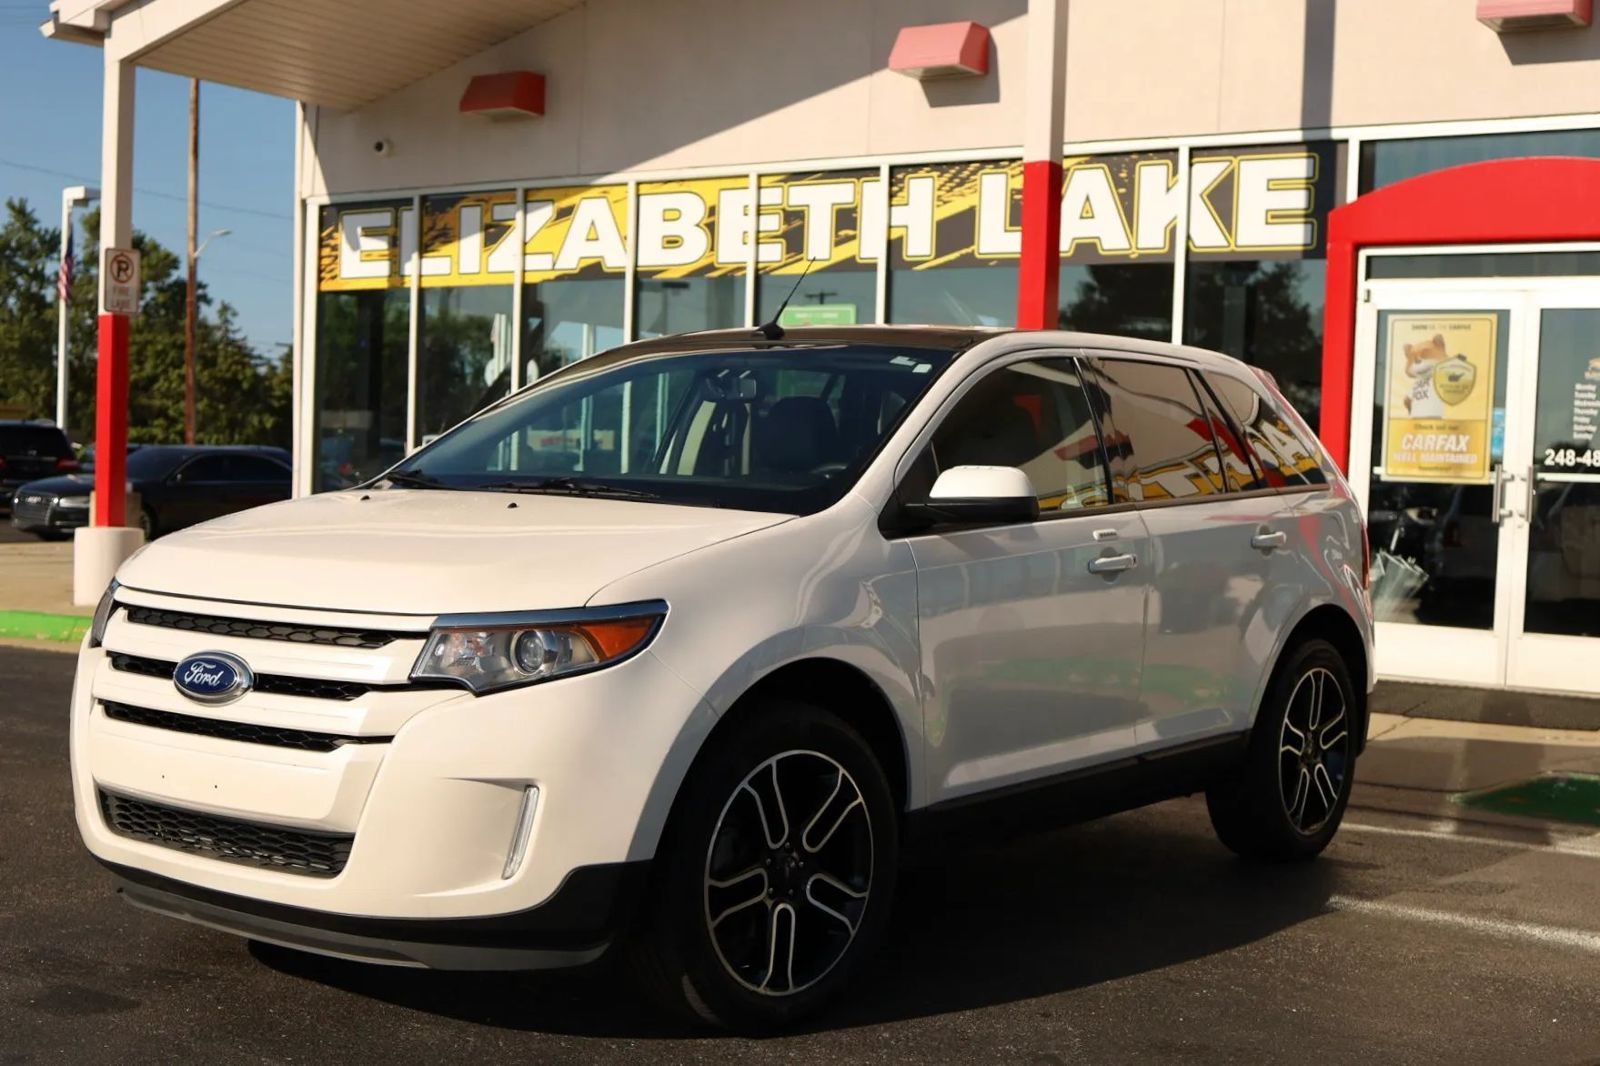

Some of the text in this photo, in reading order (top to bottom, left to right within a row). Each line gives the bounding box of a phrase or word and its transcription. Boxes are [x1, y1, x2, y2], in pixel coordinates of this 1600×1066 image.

[338, 153, 1317, 280] ELIZABETH LAKE
[1402, 433, 1470, 452] CARFAX
[1544, 448, 1600, 467] 248-48
[184, 661, 224, 687] Ford
